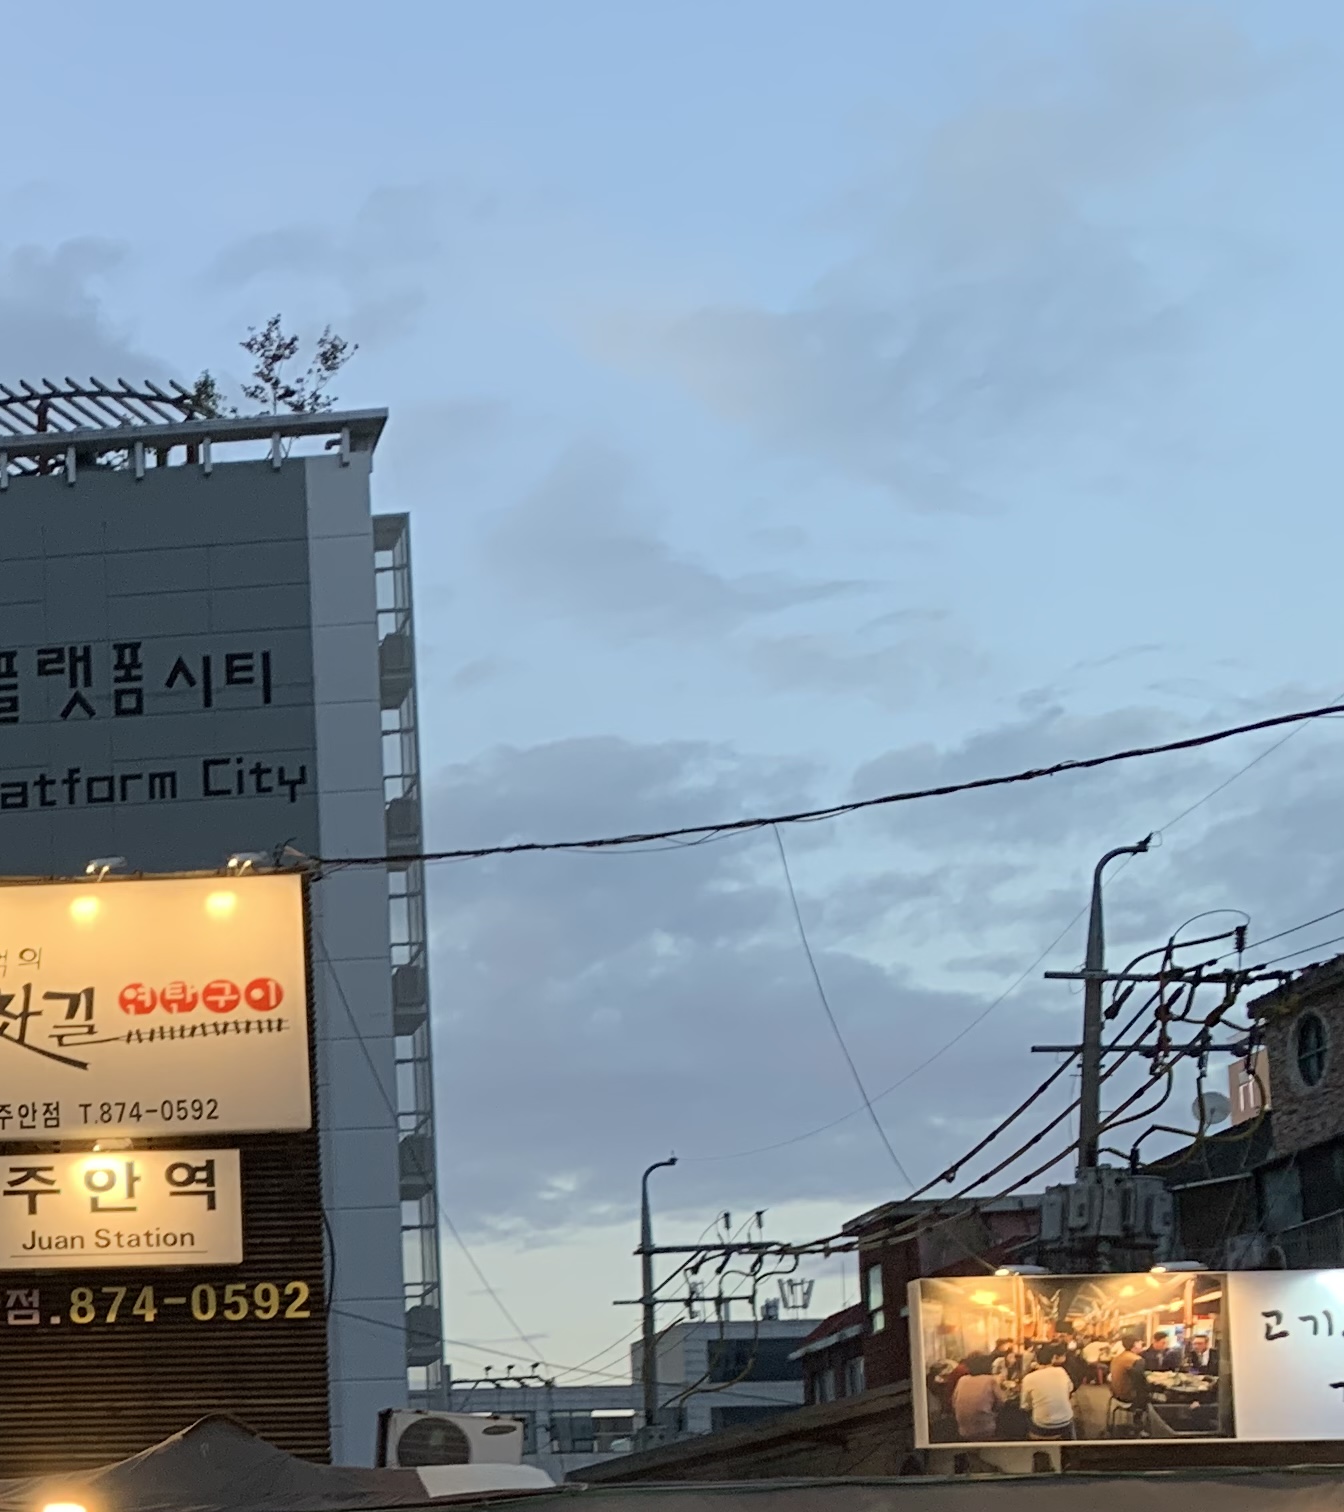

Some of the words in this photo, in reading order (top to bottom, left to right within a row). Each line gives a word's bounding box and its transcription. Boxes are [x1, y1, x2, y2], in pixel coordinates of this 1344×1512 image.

[201, 757, 308, 804] City
[118, 977, 284, 1016] 연탄구이
[78, 1098, 221, 1126] T.874-0592
[1, 1158, 218, 1216] 주안역
[21, 1231, 85, 1251] Juan
[93, 1227, 196, 1249] Station
[1260, 1309, 1344, 1342] 고기
